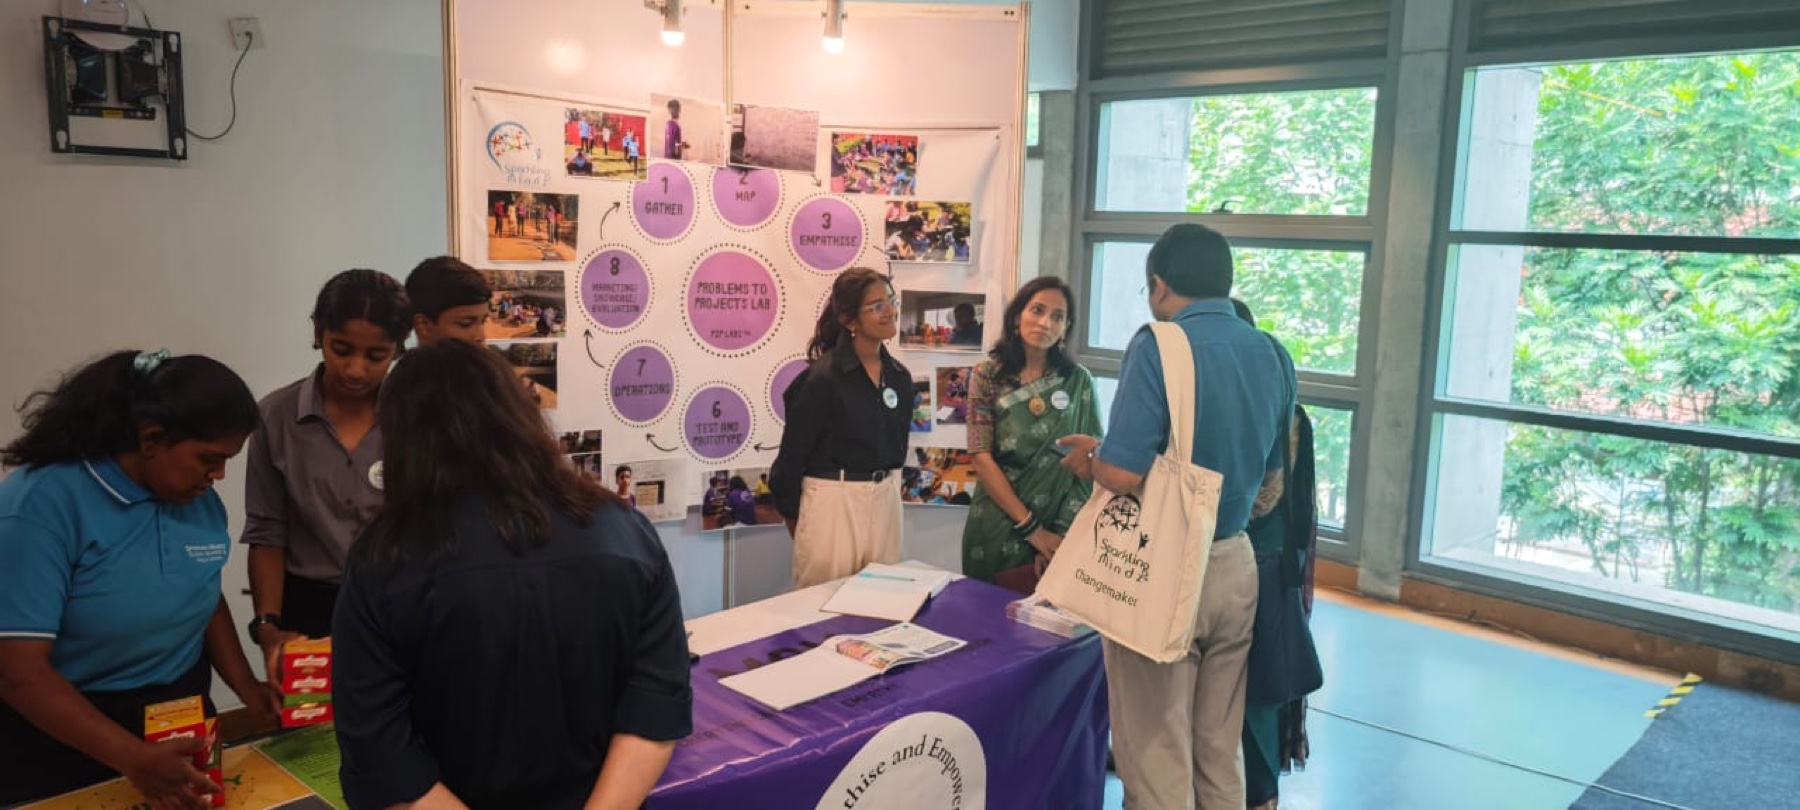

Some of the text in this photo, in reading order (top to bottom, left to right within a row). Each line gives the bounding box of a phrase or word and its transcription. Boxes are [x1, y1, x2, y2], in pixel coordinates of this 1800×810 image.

[739, 170, 748, 185] 2
[661, 176, 669, 195] 1
[735, 191, 756, 202] MAP
[645, 201, 683, 215] GATHER
[821, 212, 832, 229] 3
[799, 235, 858, 247] EMPATHISE
[610, 257, 620, 276] 8
[697, 281, 767, 295] PROBLEMS TO
[592, 304, 640, 313] EVALUATION
[694, 297, 770, 310] PROJECTS LAB
[637, 359, 647, 377] 7
[614, 383, 670, 397] OPERATIONS
[712, 401, 721, 418] 6
[697, 422, 739, 434] TEST AND
[692, 434, 742, 446] PROTOTYPE
[1100, 538, 1150, 572] Sparkling
[1075, 568, 1138, 607] Changemaker
[892, 734, 928, 766] and
[928, 737, 964, 810] Empowe
